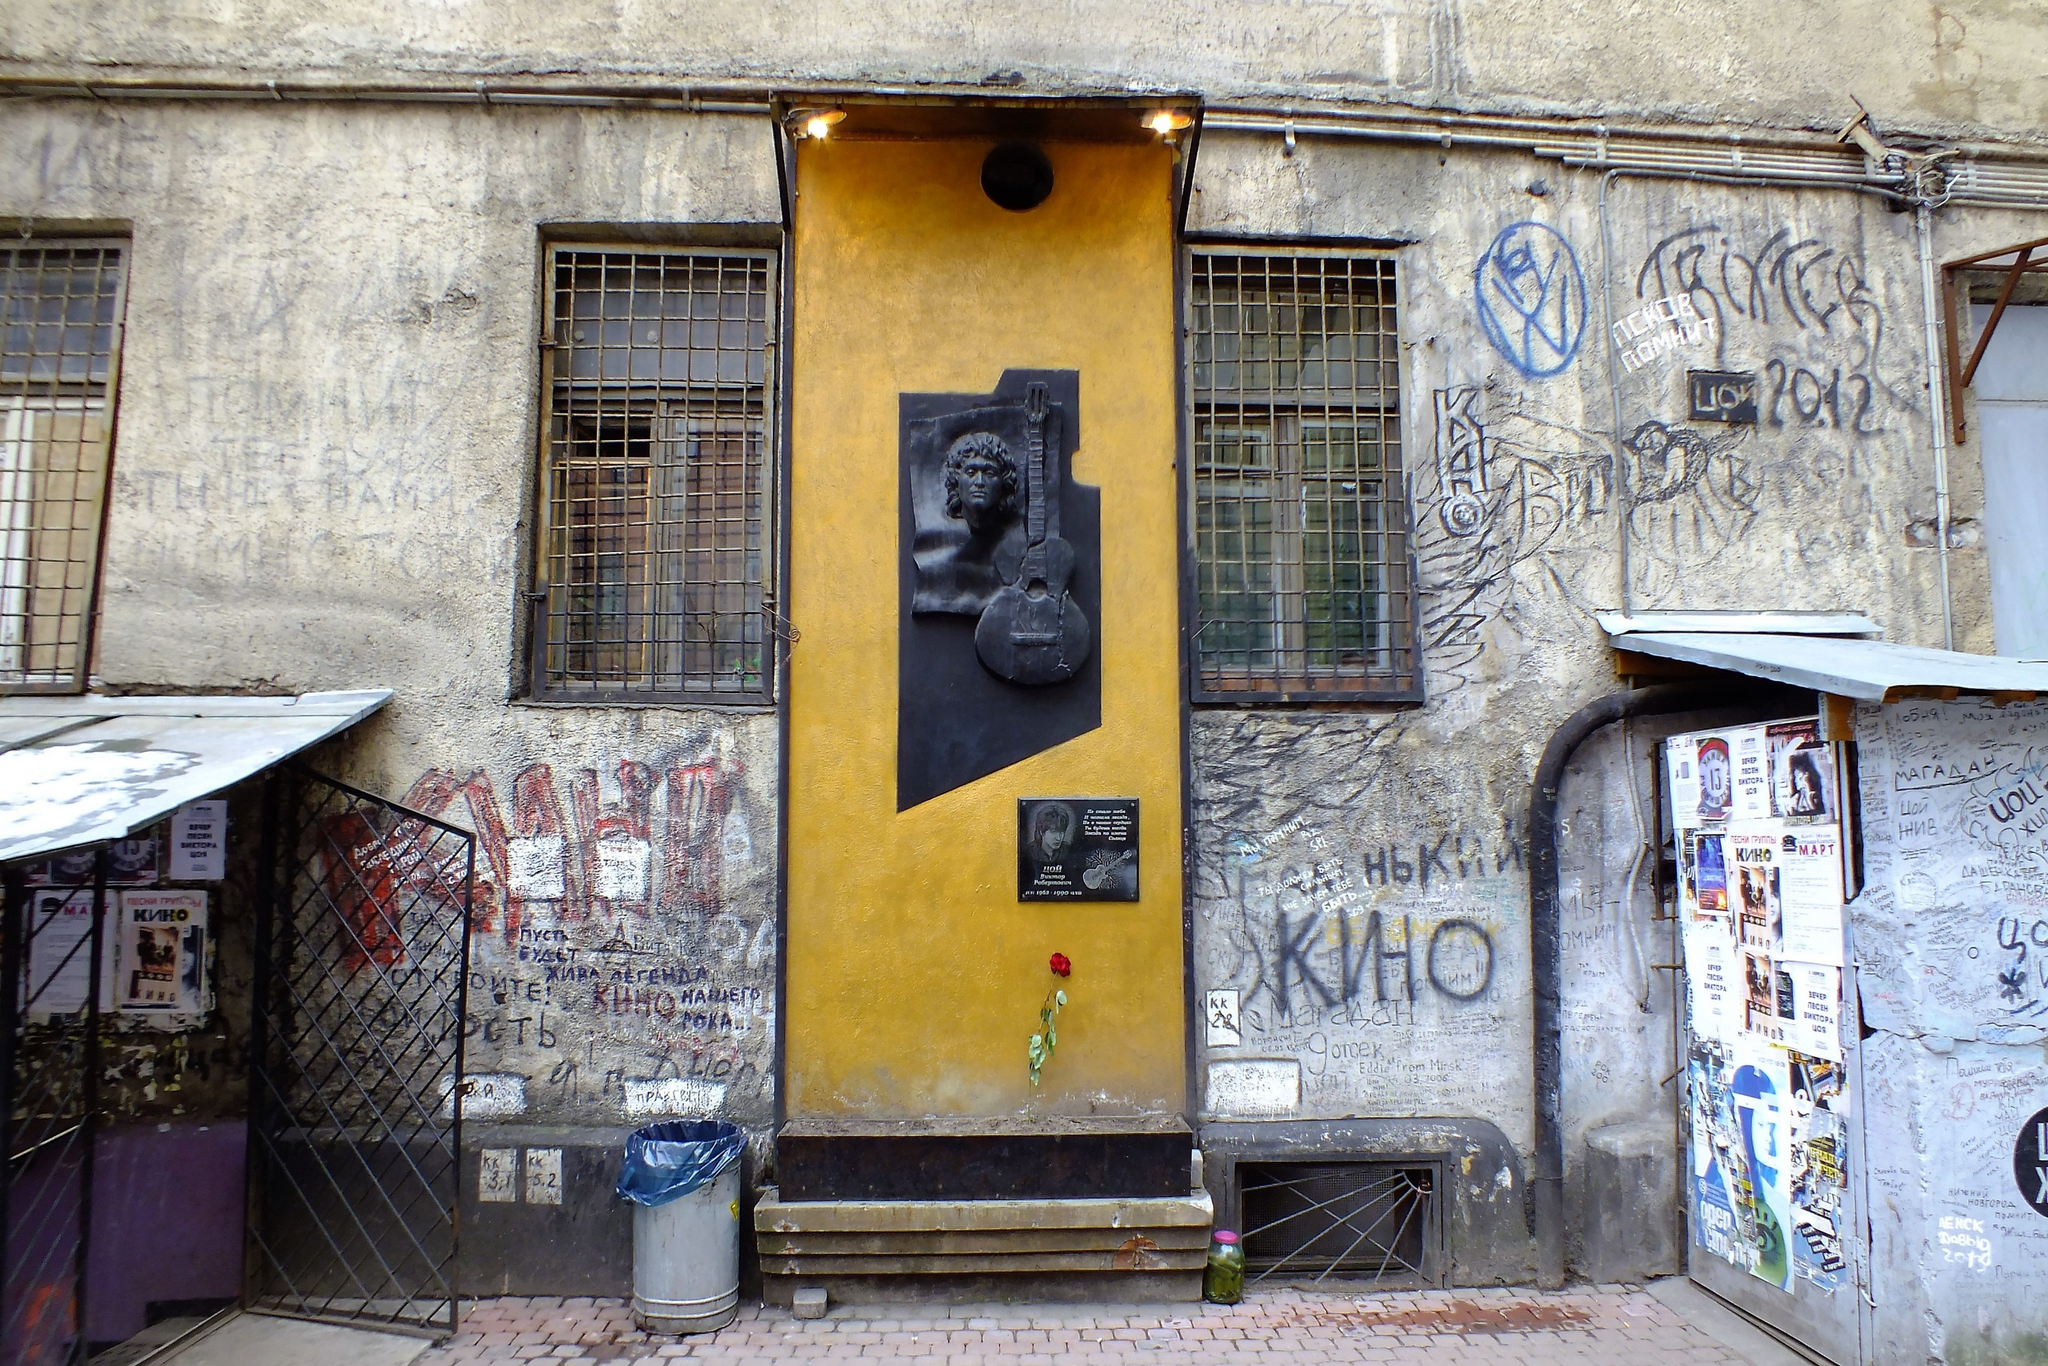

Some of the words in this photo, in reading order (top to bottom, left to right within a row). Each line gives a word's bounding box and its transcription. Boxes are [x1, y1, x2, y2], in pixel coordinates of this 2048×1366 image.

[1613, 292, 1695, 348] ПСКОВ
[1621, 317, 1715, 374] ПОМНИТ
[1895, 754, 1995, 782] МАГАДАН
[1738, 777, 1764, 786] ВИКТОРА
[1731, 835, 1750, 845] ПЕСНИ
[1752, 835, 1777, 845] ГРУППЫ
[1735, 848, 1772, 863] КИНО
[1799, 844, 1835, 856] МАРТ
[1042, 864, 1063, 873] ЦОЙ
[1317, 857, 1343, 874] БЫТЬ
[1331, 878, 1354, 894] ТЕБЕ
[133, 909, 189, 922] КИНО
[1707, 964, 1722, 972] ВЕЧЕР
[1706, 973, 1723, 982] ПЕСЕН
[1704, 982, 1727, 992] ВИКТОРА
[1808, 991, 1827, 1001] ВЕЧЕР
[1807, 1003, 1829, 1013] ПЕСЕН
[1803, 1012, 1834, 1025] ВИКТОРА
[1812, 1025, 1827, 1034] ЦОЯ
[1396, 1059, 1426, 1072] from
[1948, 1187, 1988, 1198] НИЖНИЙ
[1968, 1199, 2017, 1209] НОВГОРОД
